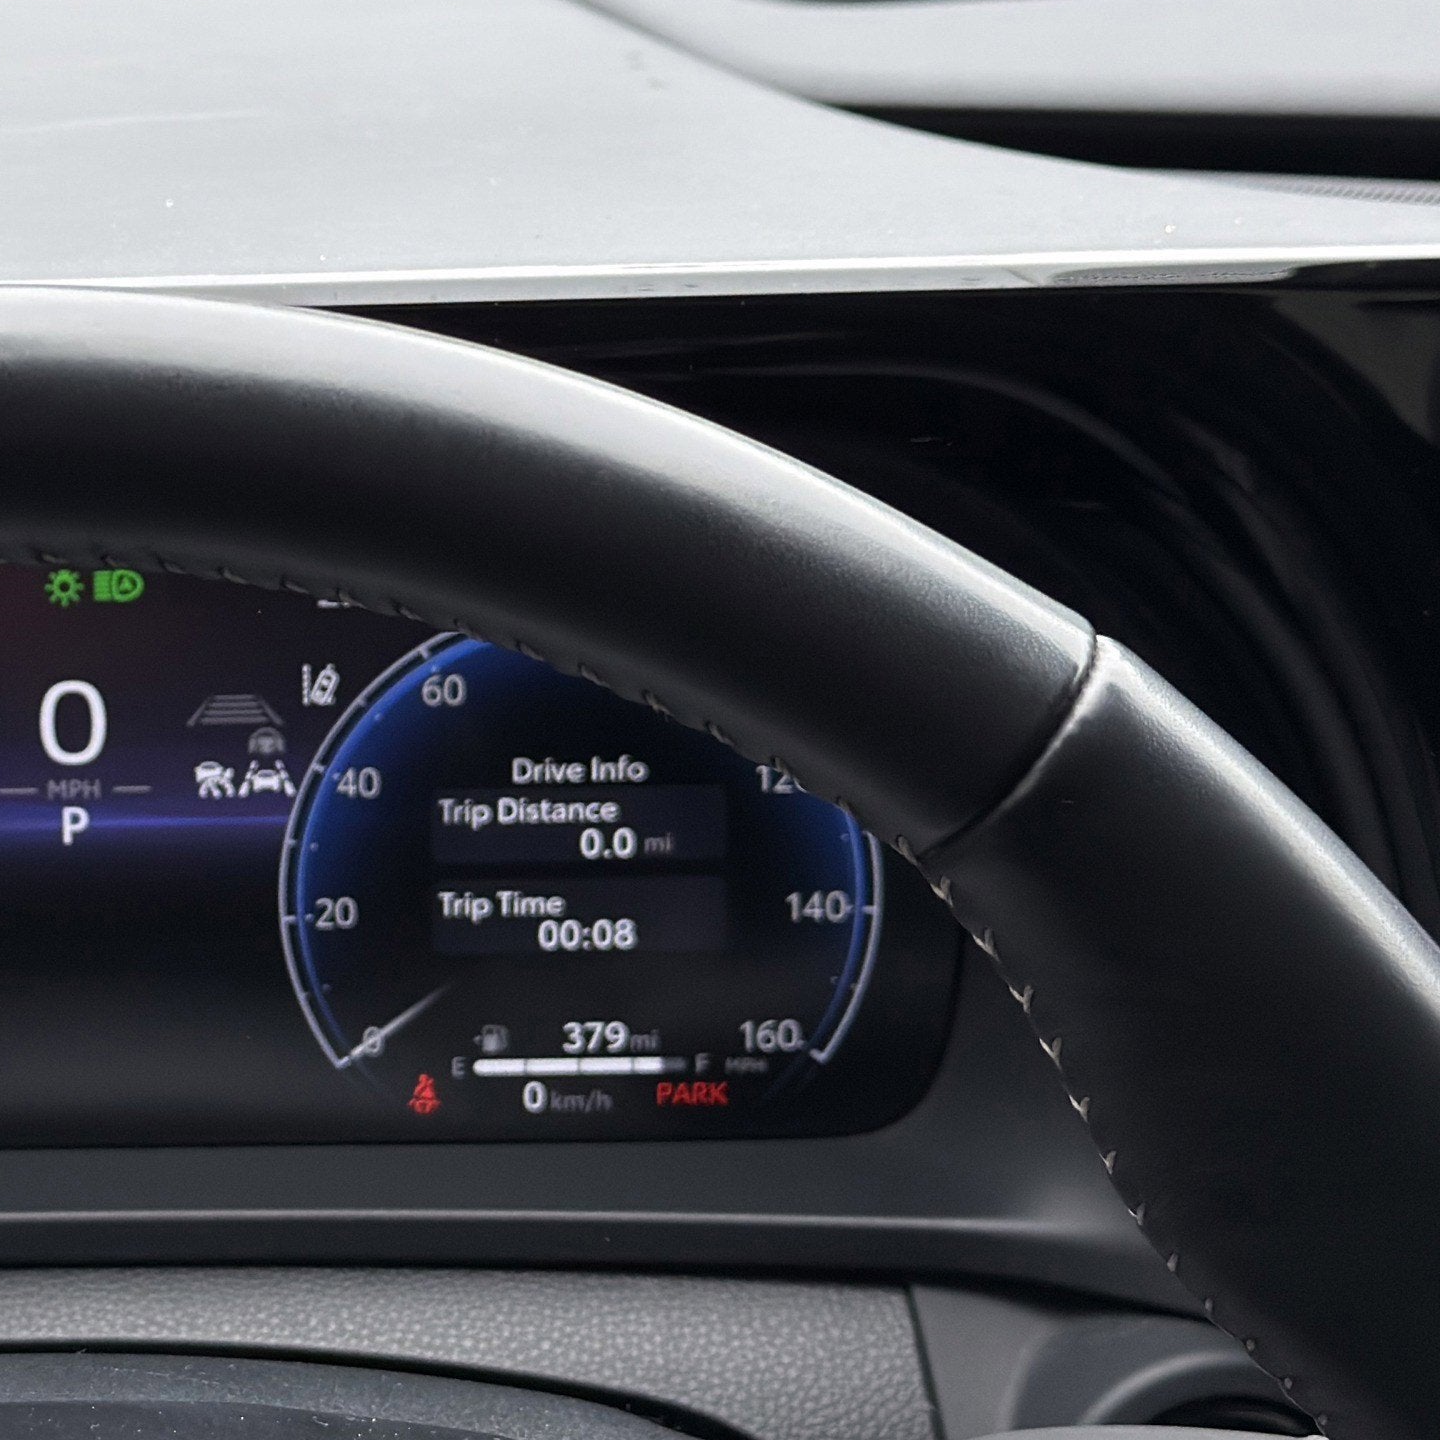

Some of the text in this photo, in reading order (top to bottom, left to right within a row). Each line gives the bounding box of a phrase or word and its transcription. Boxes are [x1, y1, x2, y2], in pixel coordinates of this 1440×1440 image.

[421, 672, 466, 708] 60
[39, 680, 107, 766] 0
[336, 766, 382, 800] 40
[512, 754, 650, 785] Drive Info
[47, 779, 102, 800] MPH
[61, 807, 91, 846] P
[438, 796, 621, 831] Trip Distance
[579, 827, 675, 860] 0.0 mi
[315, 896, 360, 931] 20
[438, 890, 567, 925] Trip Time
[785, 890, 850, 924] 140
[537, 918, 640, 952] 00:08
[561, 1020, 629, 1054] 379
[740, 1019, 799, 1053] 160
[522, 1079, 549, 1114] 0
[656, 1081, 729, 1107] PARK
